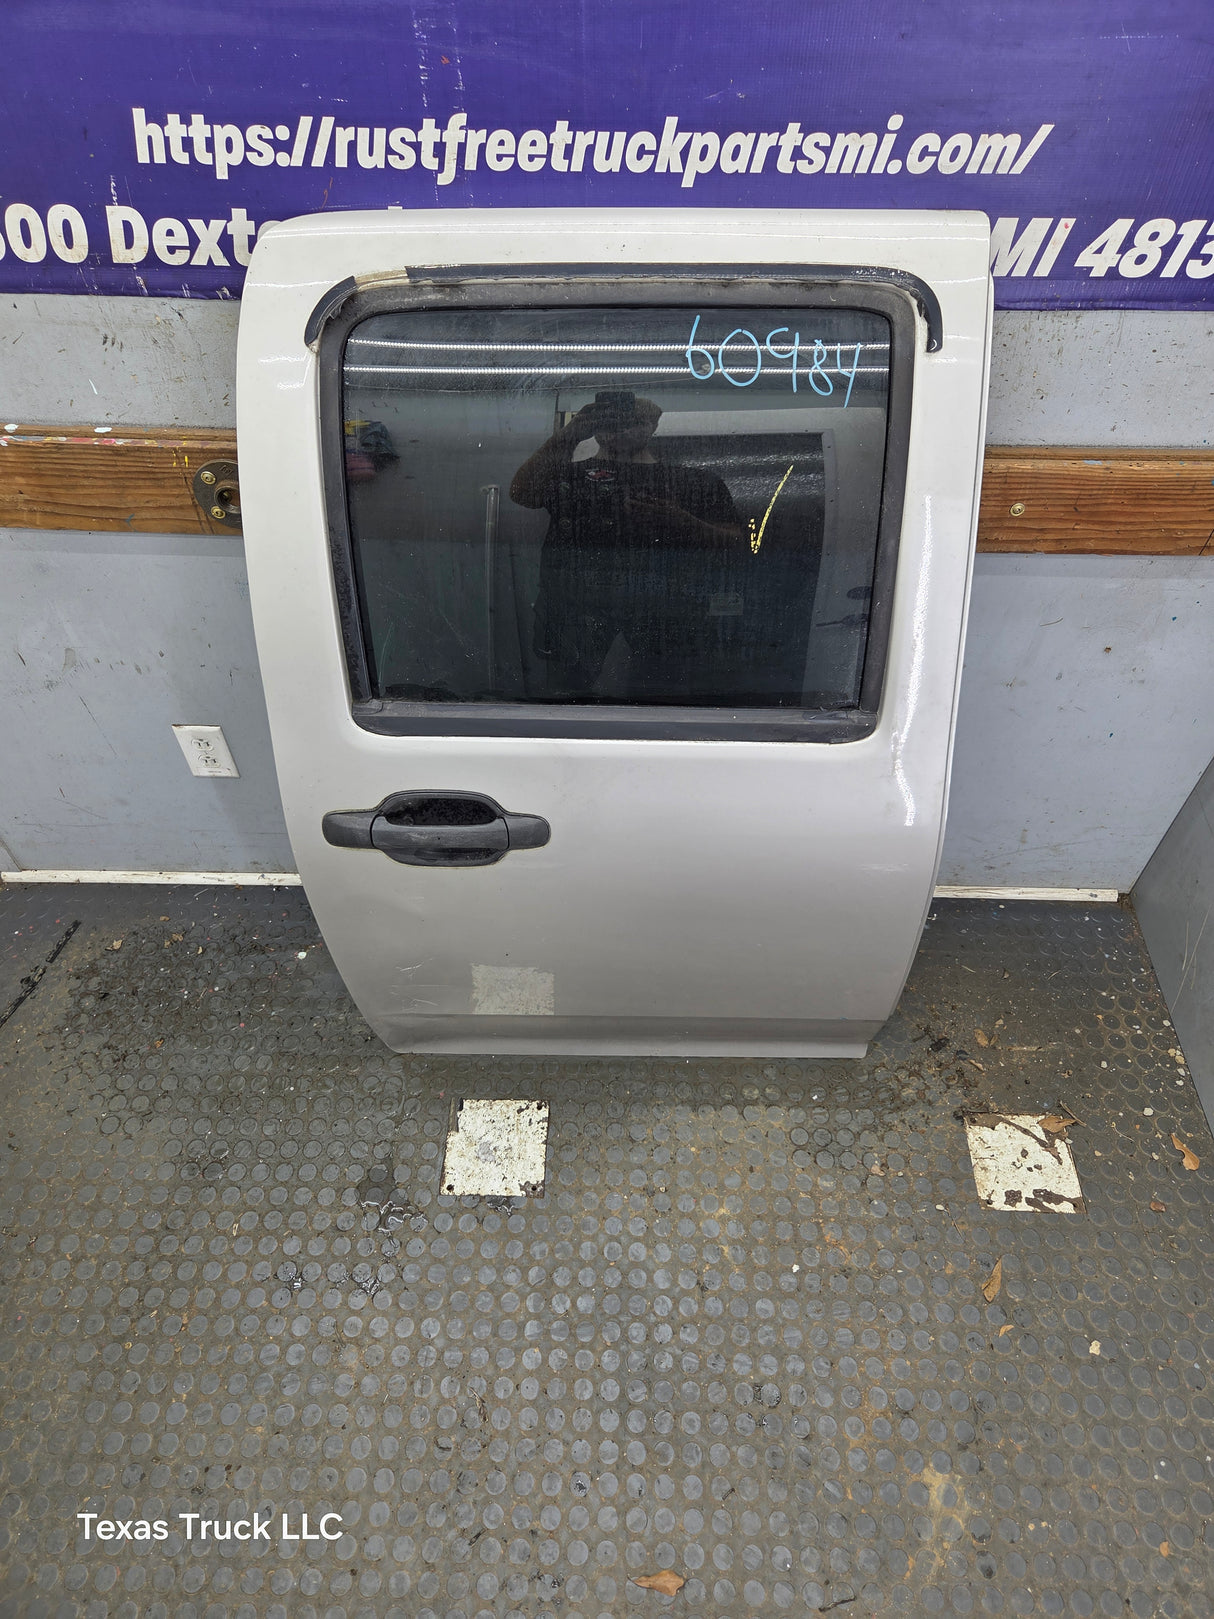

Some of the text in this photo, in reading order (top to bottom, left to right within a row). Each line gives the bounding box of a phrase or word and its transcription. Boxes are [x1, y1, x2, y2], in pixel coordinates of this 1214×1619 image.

[132, 107, 1054, 188] https://rustfreetruckpartsmi.com/
[0, 203, 281, 266] 00 Dext
[990, 217, 1076, 277] MI
[686, 315, 861, 408] 60984
